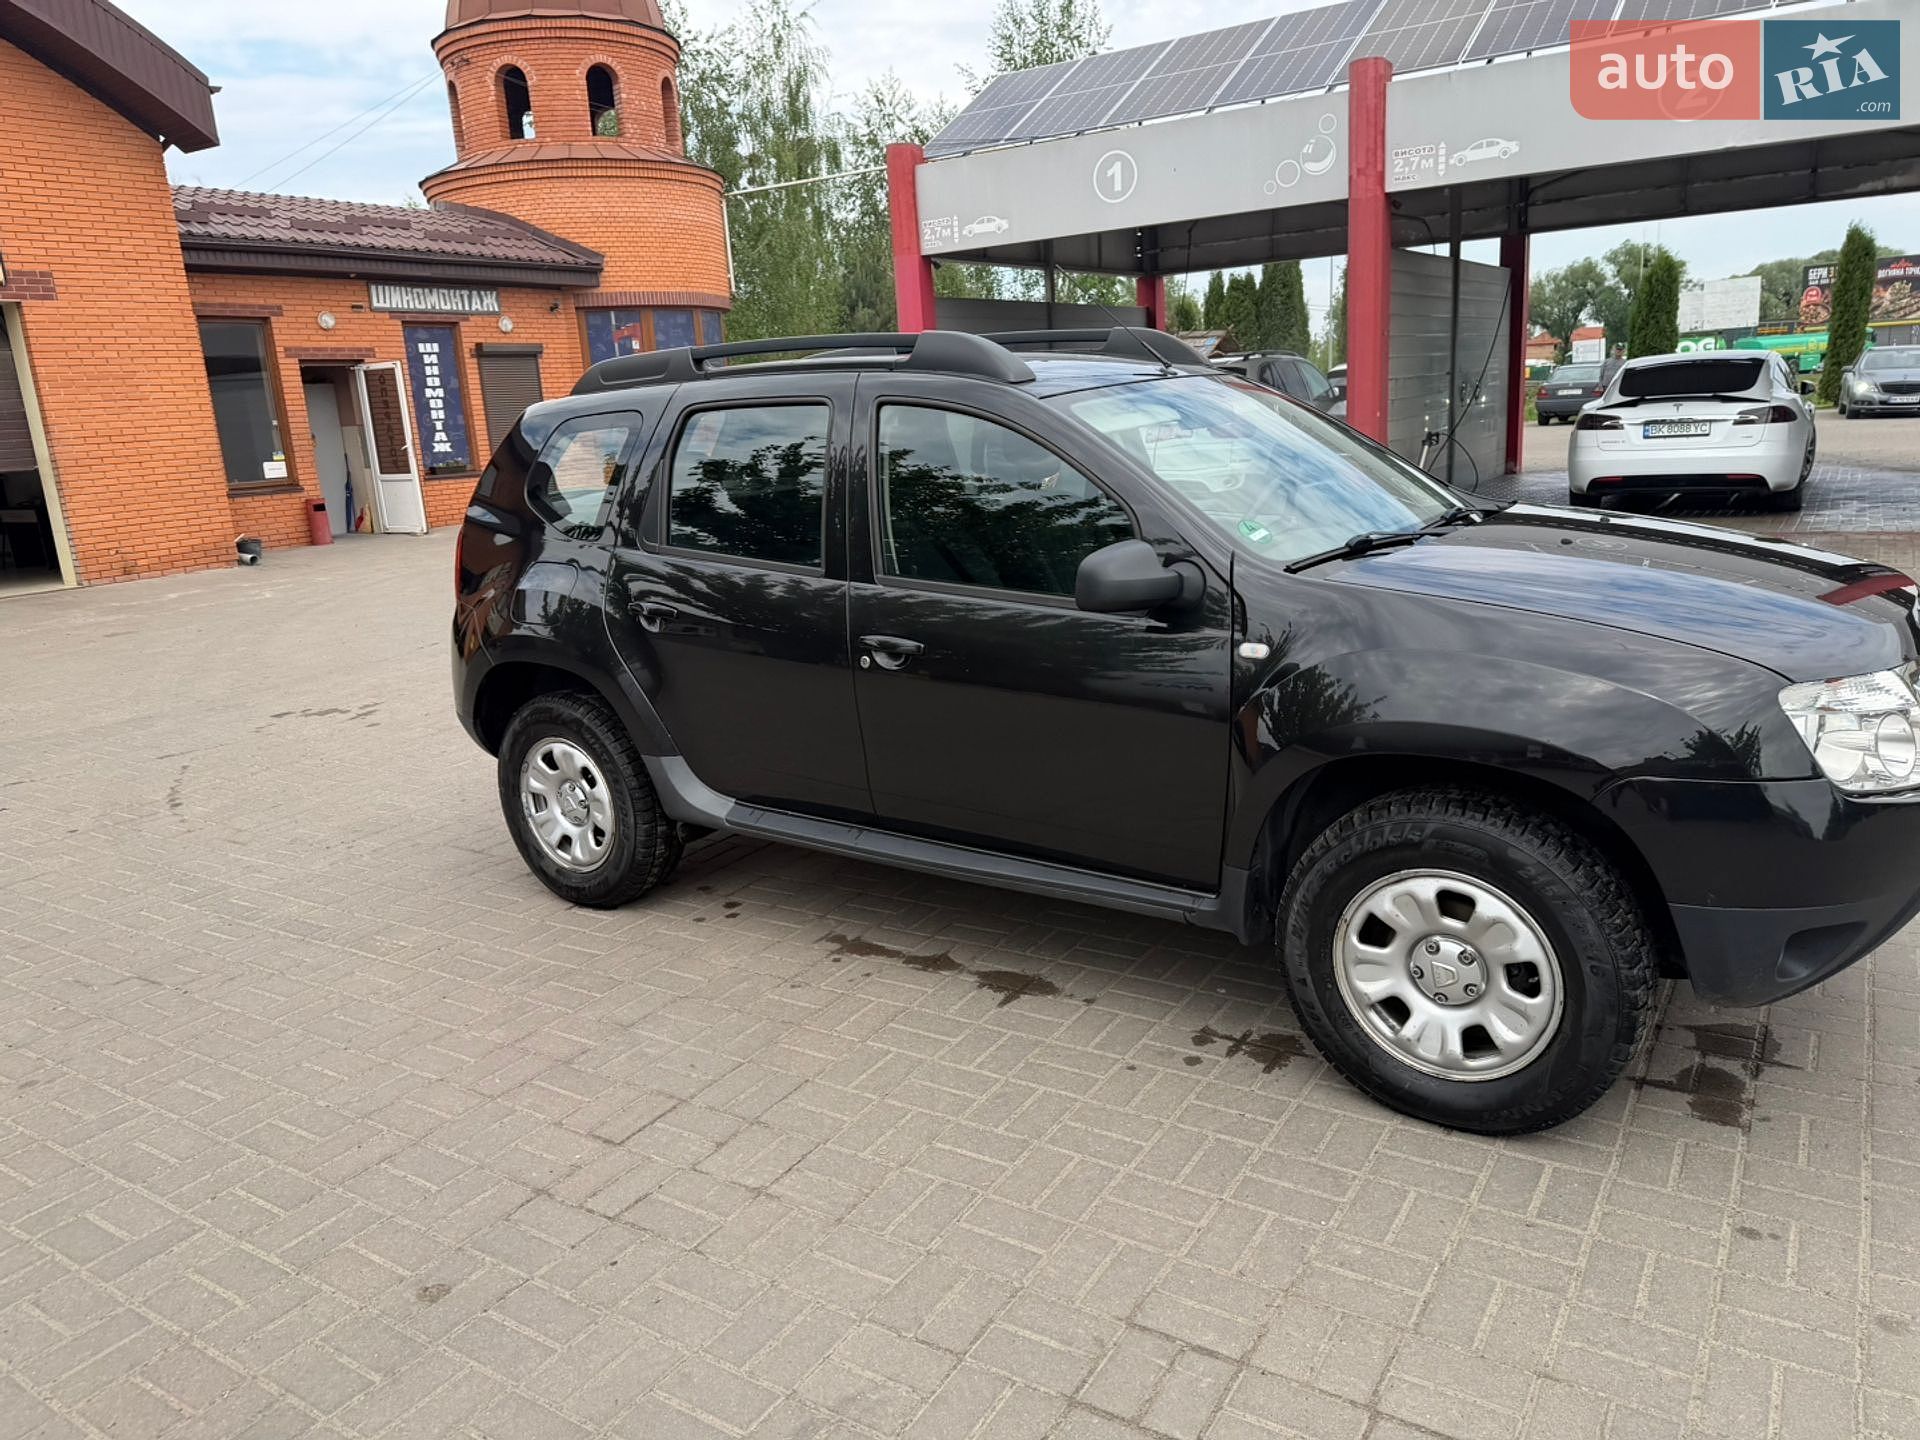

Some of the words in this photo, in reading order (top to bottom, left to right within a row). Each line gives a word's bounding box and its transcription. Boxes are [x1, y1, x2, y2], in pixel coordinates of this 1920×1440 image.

[1106, 161, 1122, 192] 1
[371, 284, 499, 312] ШИНОМОНТАЖ
[417, 342, 453, 453] ШИНОМОНТАЖ
